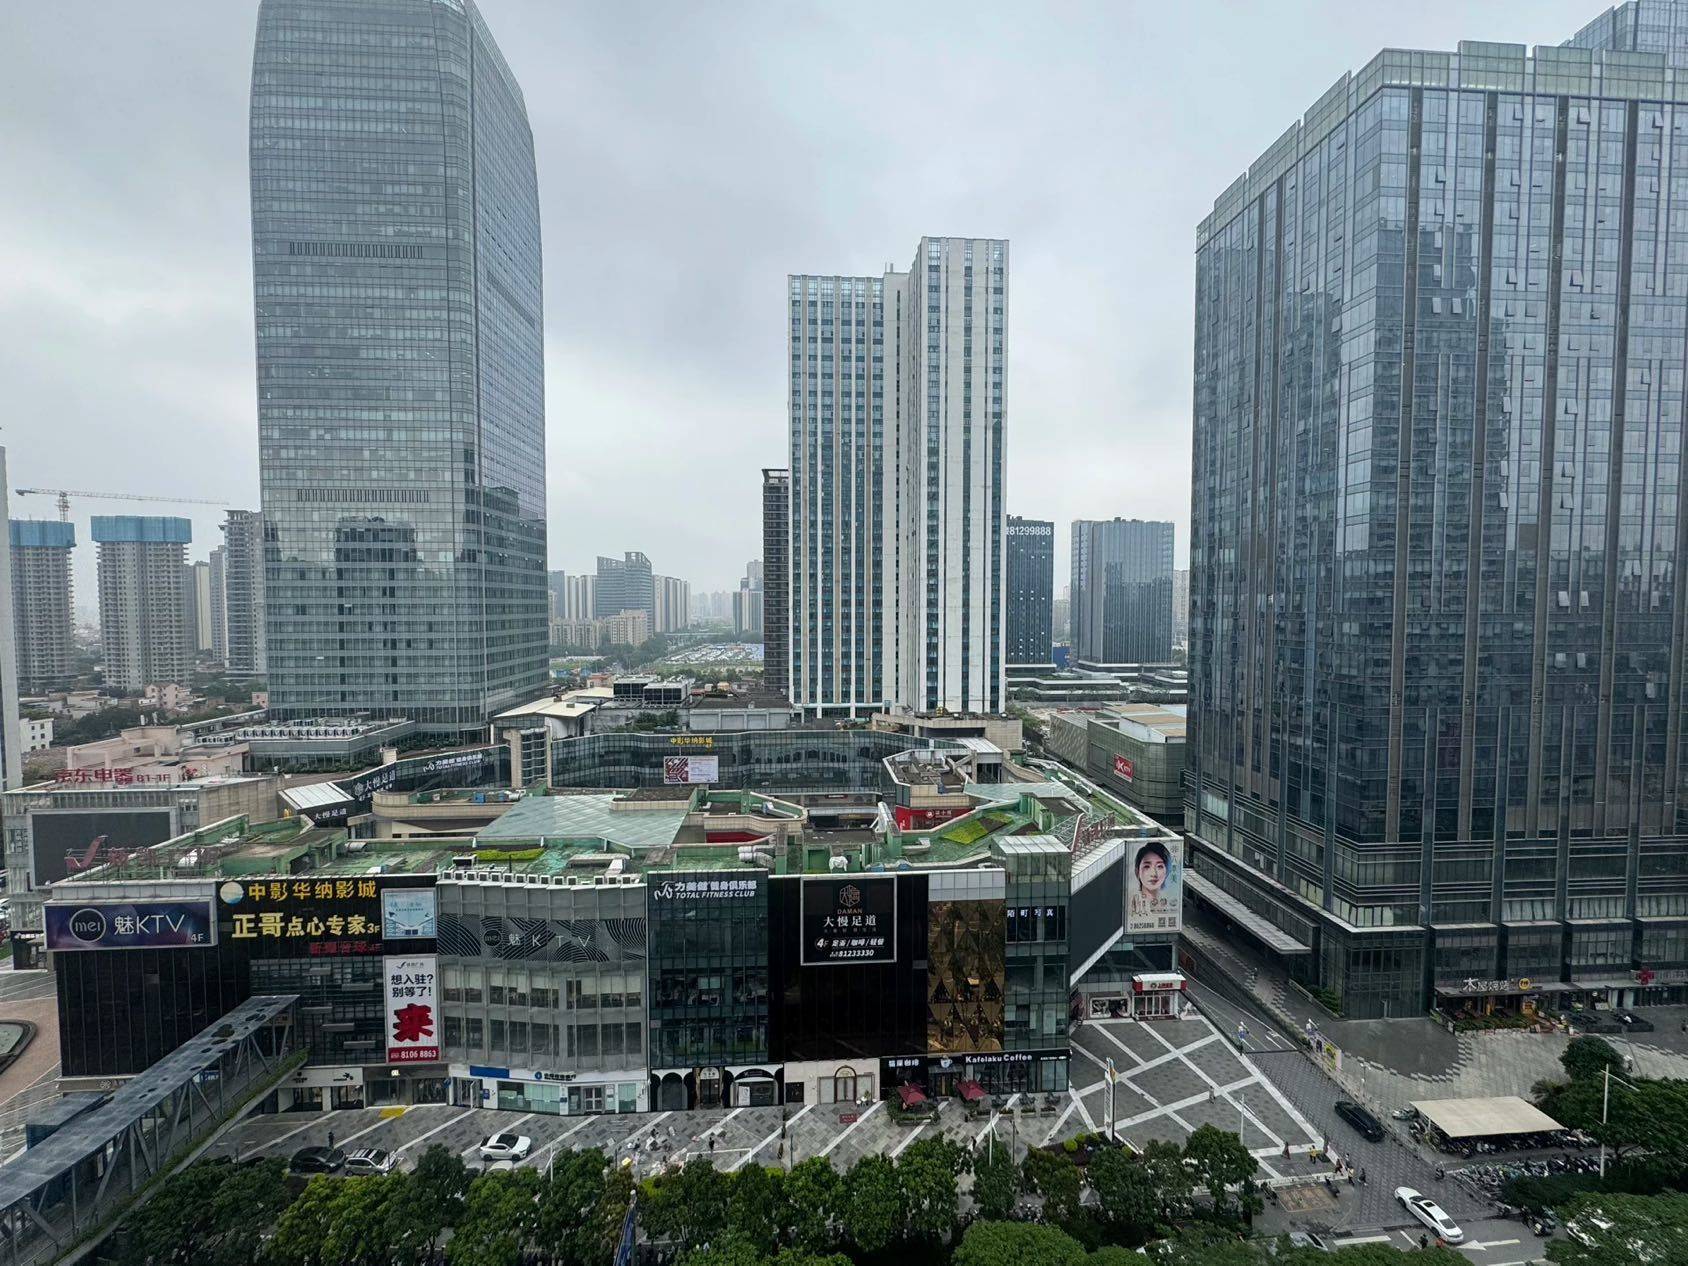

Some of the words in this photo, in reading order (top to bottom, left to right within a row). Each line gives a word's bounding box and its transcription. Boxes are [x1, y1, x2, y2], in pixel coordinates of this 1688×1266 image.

[54, 768, 133, 785] 京东电器
[248, 879, 377, 901] 中影华纳影城
[114, 914, 186, 936] 魅KTV
[231, 912, 367, 938] 正哥点心专家
[367, 923, 381, 934] 3F
[824, 915, 877, 927] 大慢足道
[190, 933, 204, 943] 4F
[392, 986, 433, 998] 别等了!
[393, 1003, 434, 1042] 来
[1003, 1053, 1033, 1062] Coffee
